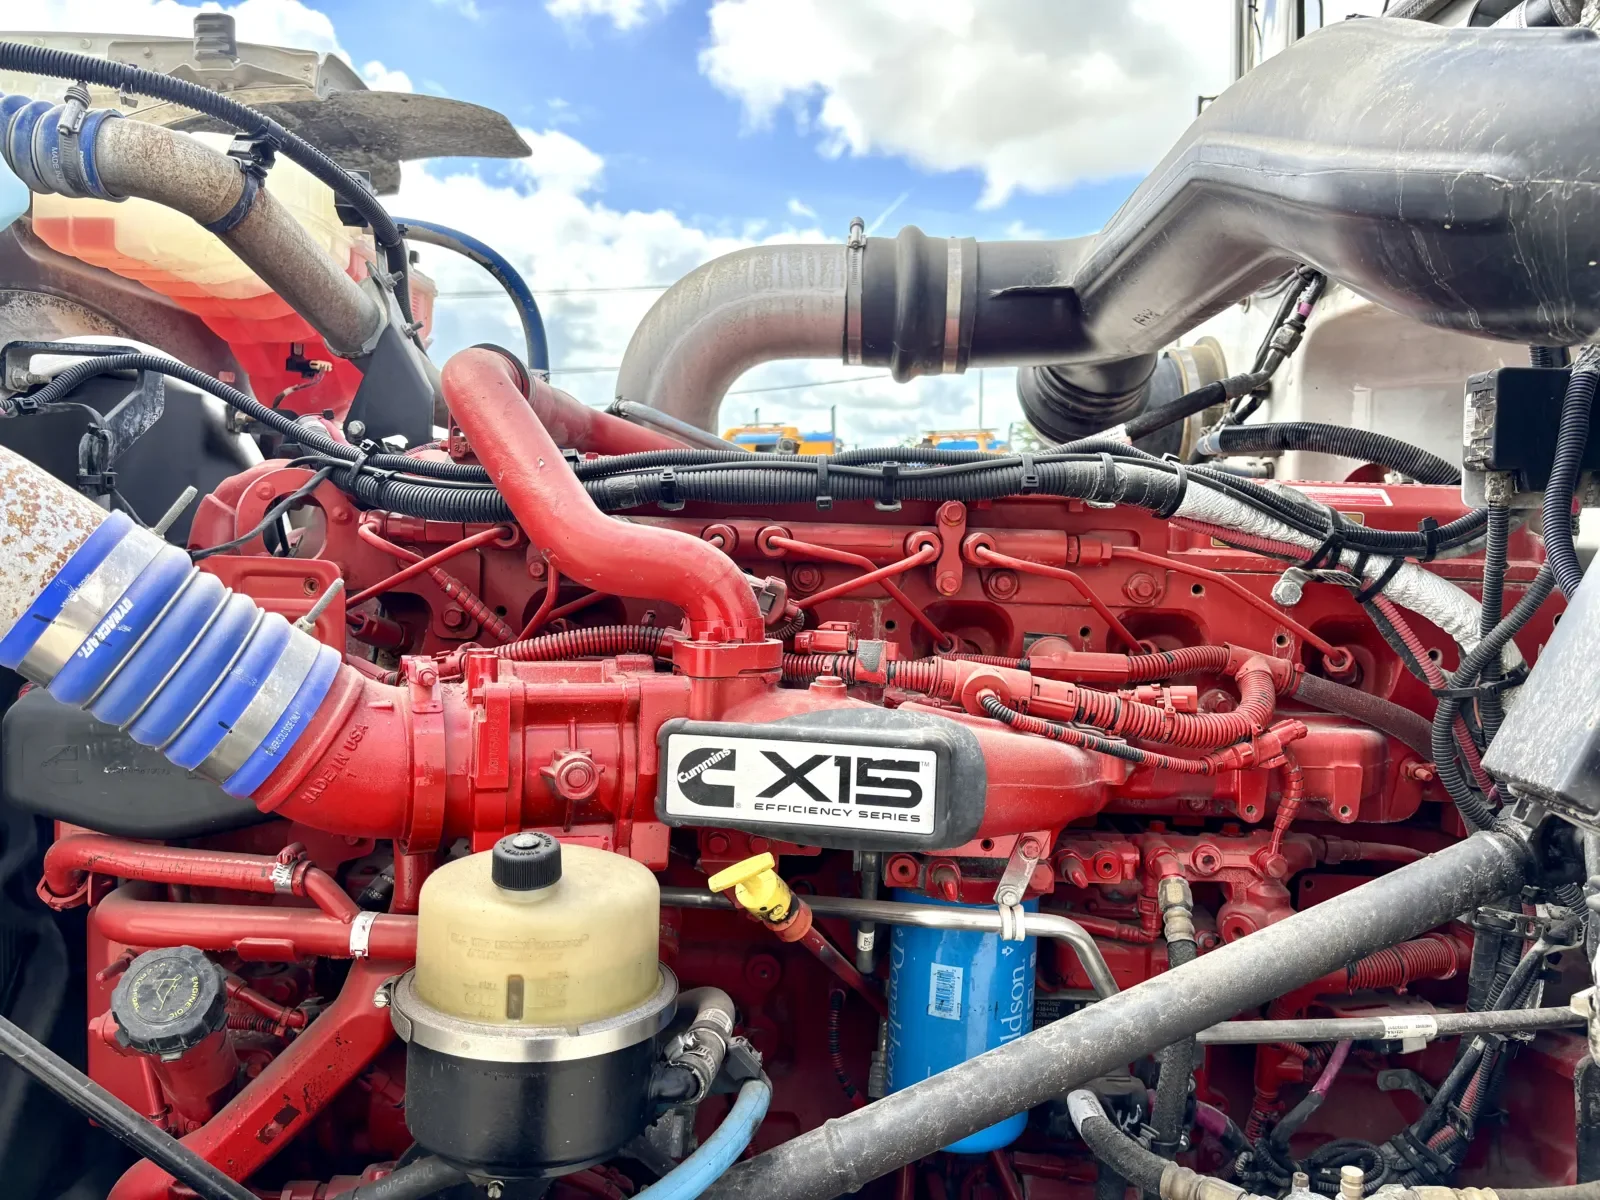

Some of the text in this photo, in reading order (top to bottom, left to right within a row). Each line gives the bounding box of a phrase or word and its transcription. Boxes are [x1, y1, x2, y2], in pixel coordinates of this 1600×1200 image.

[51, 146, 59, 169] MADE
[81, 597, 134, 659] DYNACRAFT
[301, 723, 369, 804] MADE IN USA
[677, 748, 731, 783] Cummins
[755, 750, 924, 808] X15
[754, 803, 921, 823] EFFICIENCY SERIES
[168, 976, 200, 1018] ENGINE OIL
[887, 942, 905, 1088] Donaldson
